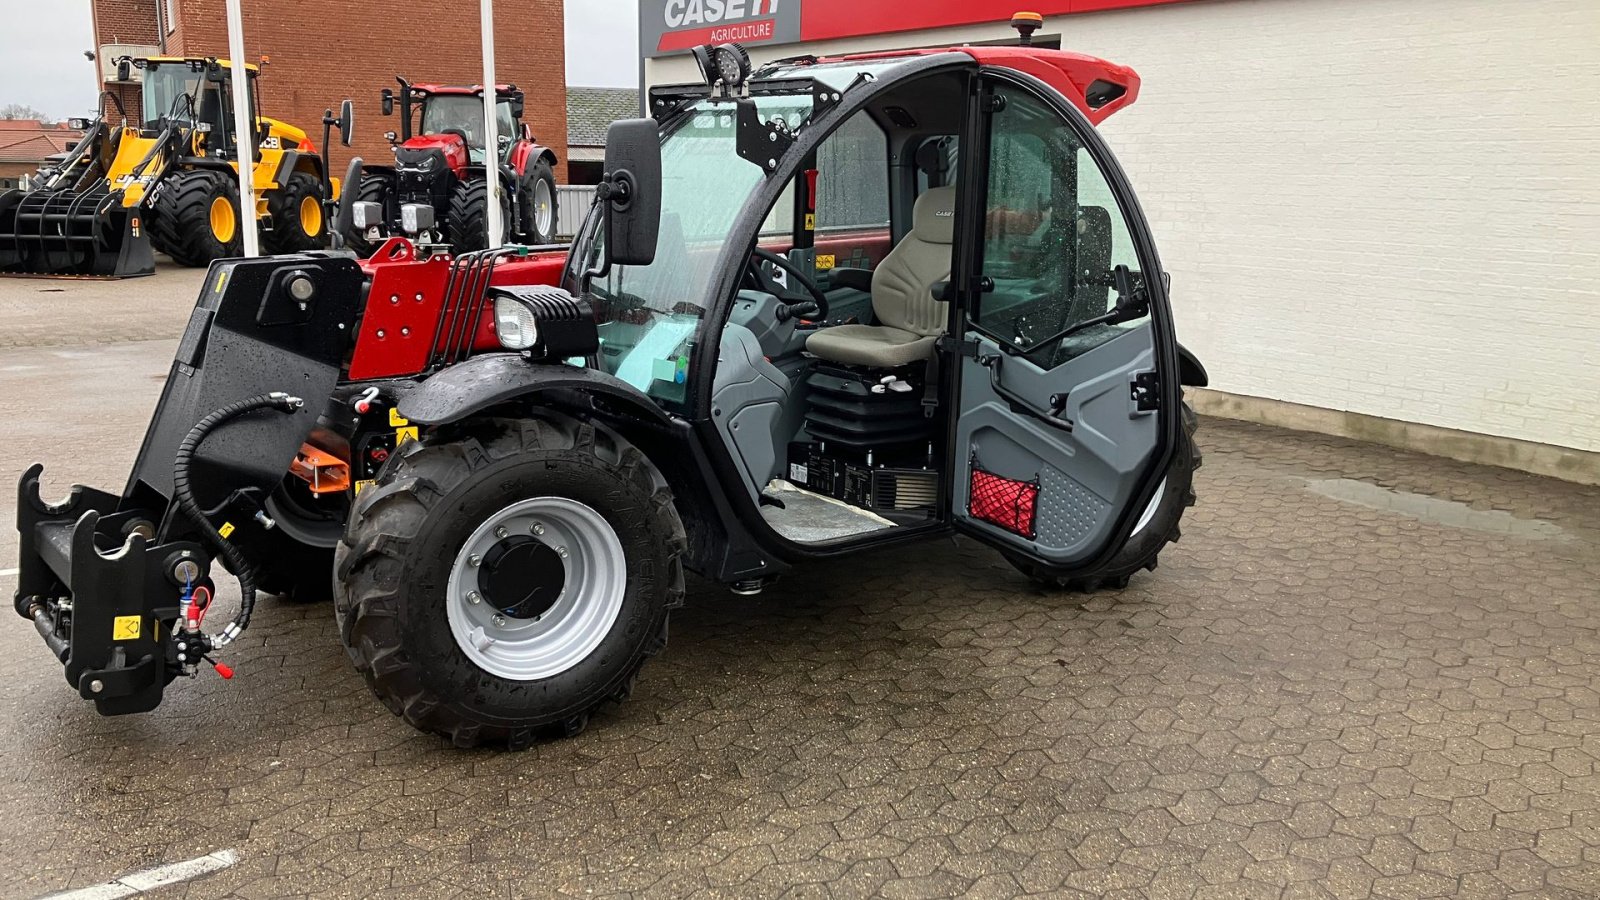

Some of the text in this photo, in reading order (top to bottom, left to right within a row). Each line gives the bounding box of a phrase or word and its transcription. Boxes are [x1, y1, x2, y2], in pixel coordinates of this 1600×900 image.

[664, 0, 746, 28] CASE
[711, 23, 770, 42] AGRICULTURE
[146, 181, 165, 209] JCB
